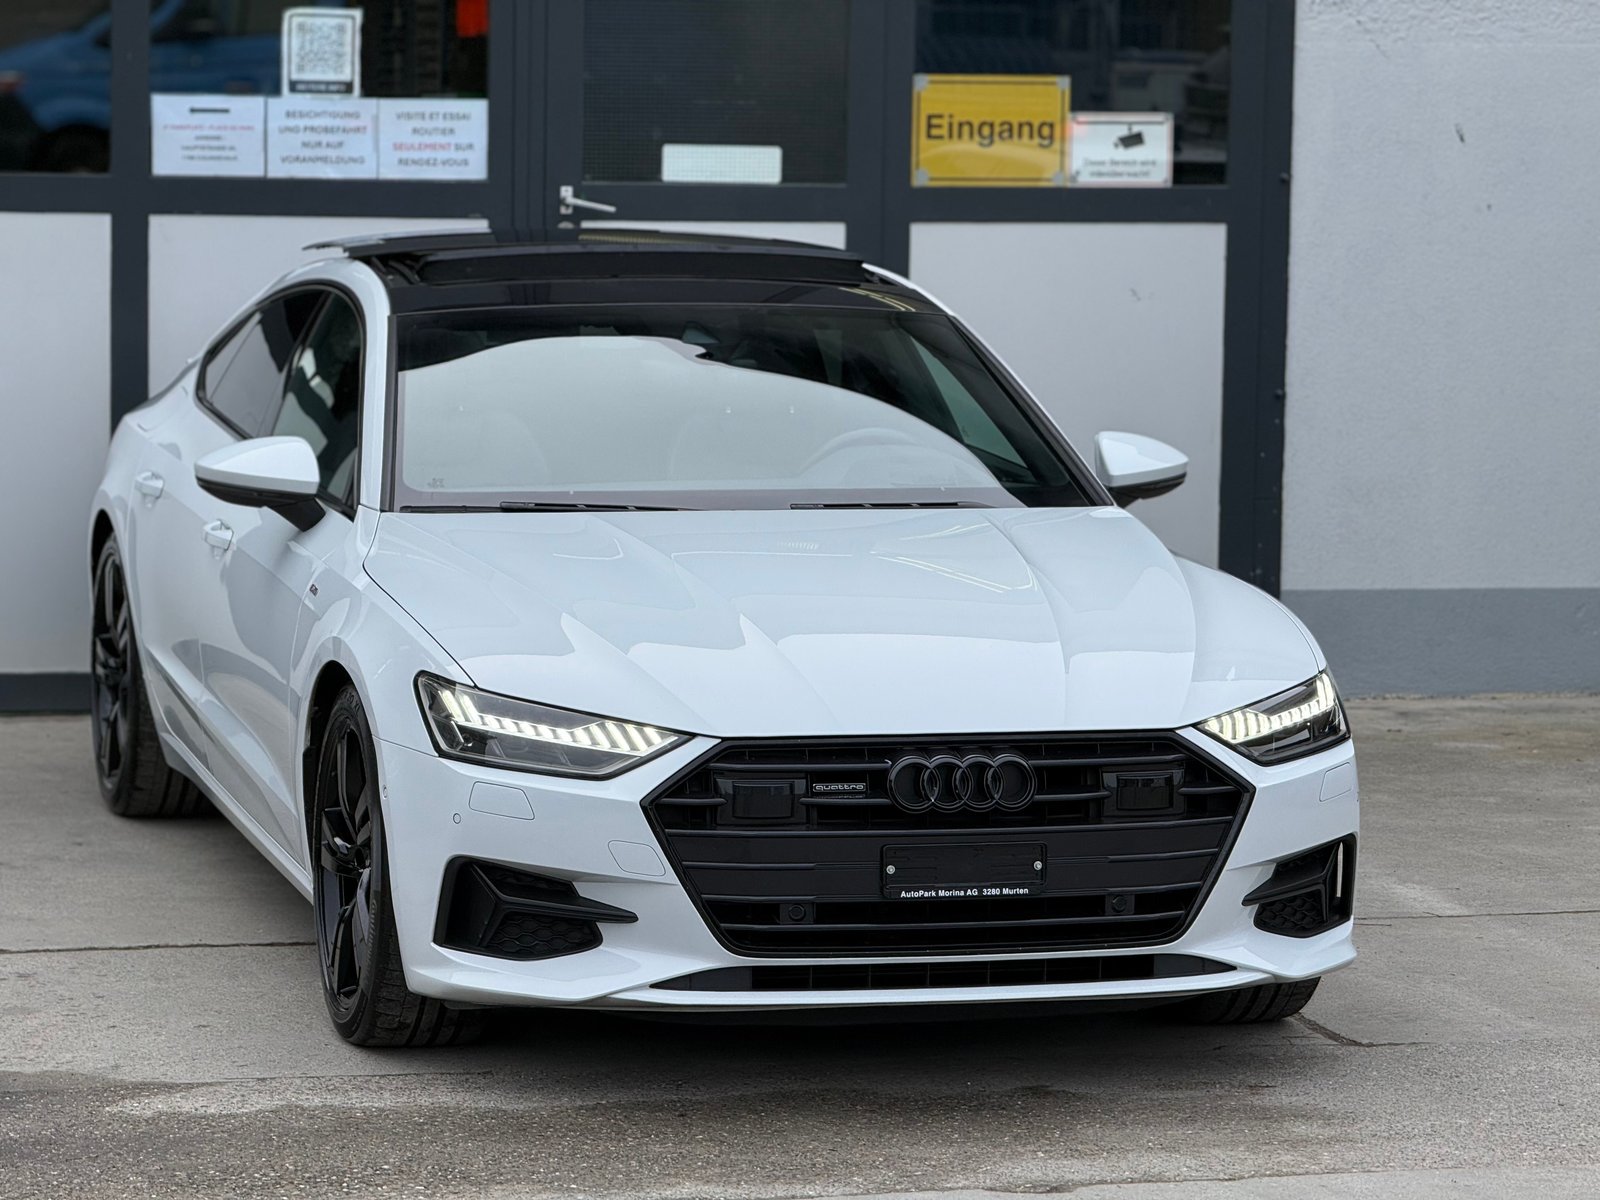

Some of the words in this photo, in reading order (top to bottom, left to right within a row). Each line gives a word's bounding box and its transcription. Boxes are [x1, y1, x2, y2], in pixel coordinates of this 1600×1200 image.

[285, 110, 361, 119] BESICHTIGUNG
[395, 111, 426, 121] VISITE
[428, 111, 439, 121] ET
[442, 112, 471, 121] ESSAI
[278, 125, 300, 134] UND
[303, 125, 367, 134] PROBEFAHRT
[411, 127, 455, 136] ROUTIER
[925, 114, 1055, 148] Eingang
[301, 141, 322, 149] NUR
[325, 141, 344, 149] AUF
[392, 142, 452, 152] SEULEMENT
[454, 143, 474, 152] SUR
[281, 155, 366, 164] VORANMELDUNG
[397, 157, 469, 167] RENDEZ-VOUS
[900, 889, 936, 898] AutoPark
[938, 889, 964, 897] Morina
[966, 888, 978, 896] AG
[982, 888, 1000, 896] 3280
[1002, 887, 1029, 895] Murten
